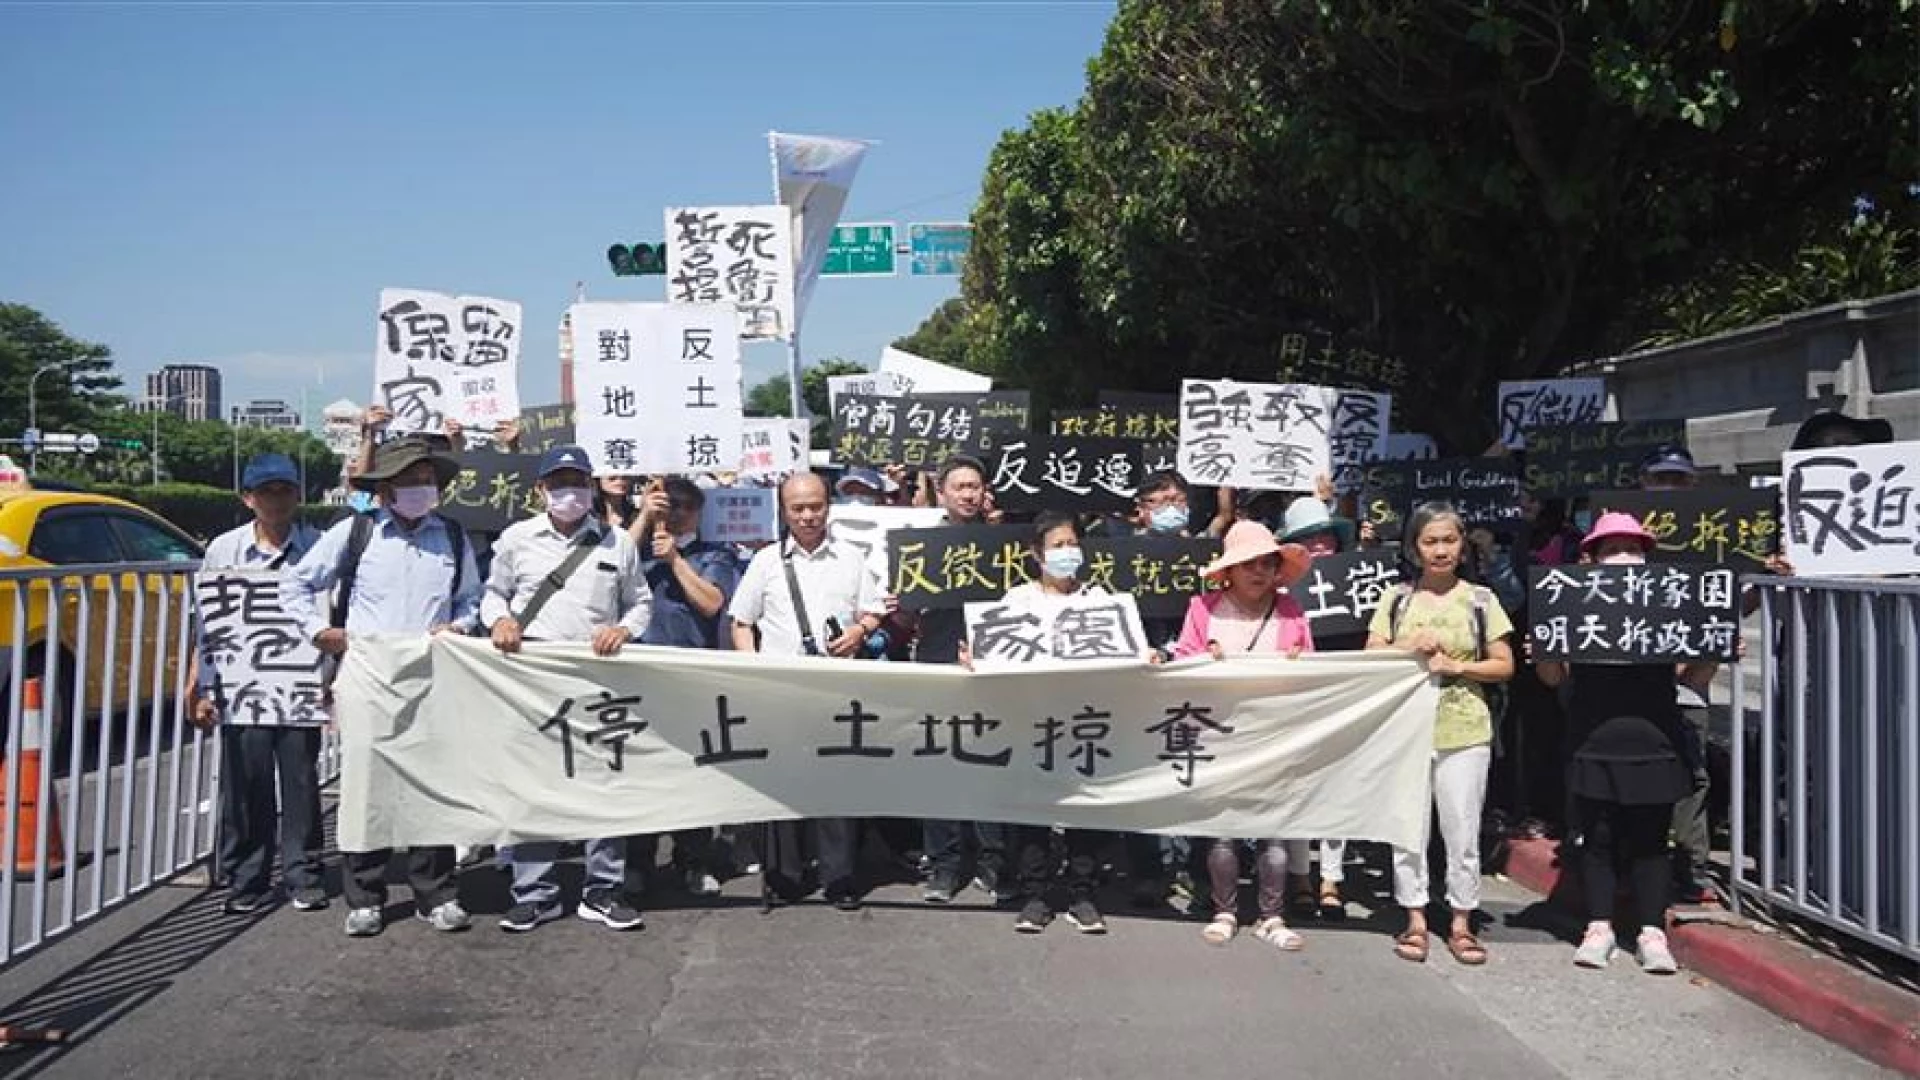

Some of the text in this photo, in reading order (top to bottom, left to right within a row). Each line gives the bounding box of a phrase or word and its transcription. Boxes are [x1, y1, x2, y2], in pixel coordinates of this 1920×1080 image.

[379, 300, 514, 367] 保留
[838, 398, 974, 442] 官商勾結
[991, 442, 1138, 498] 反迫遷
[1787, 456, 1920, 556] 反迫
[974, 604, 1138, 662] 家園
[1533, 613, 1739, 659] 明天拆政府
[538, 690, 1233, 787] 停止土地掠奪
